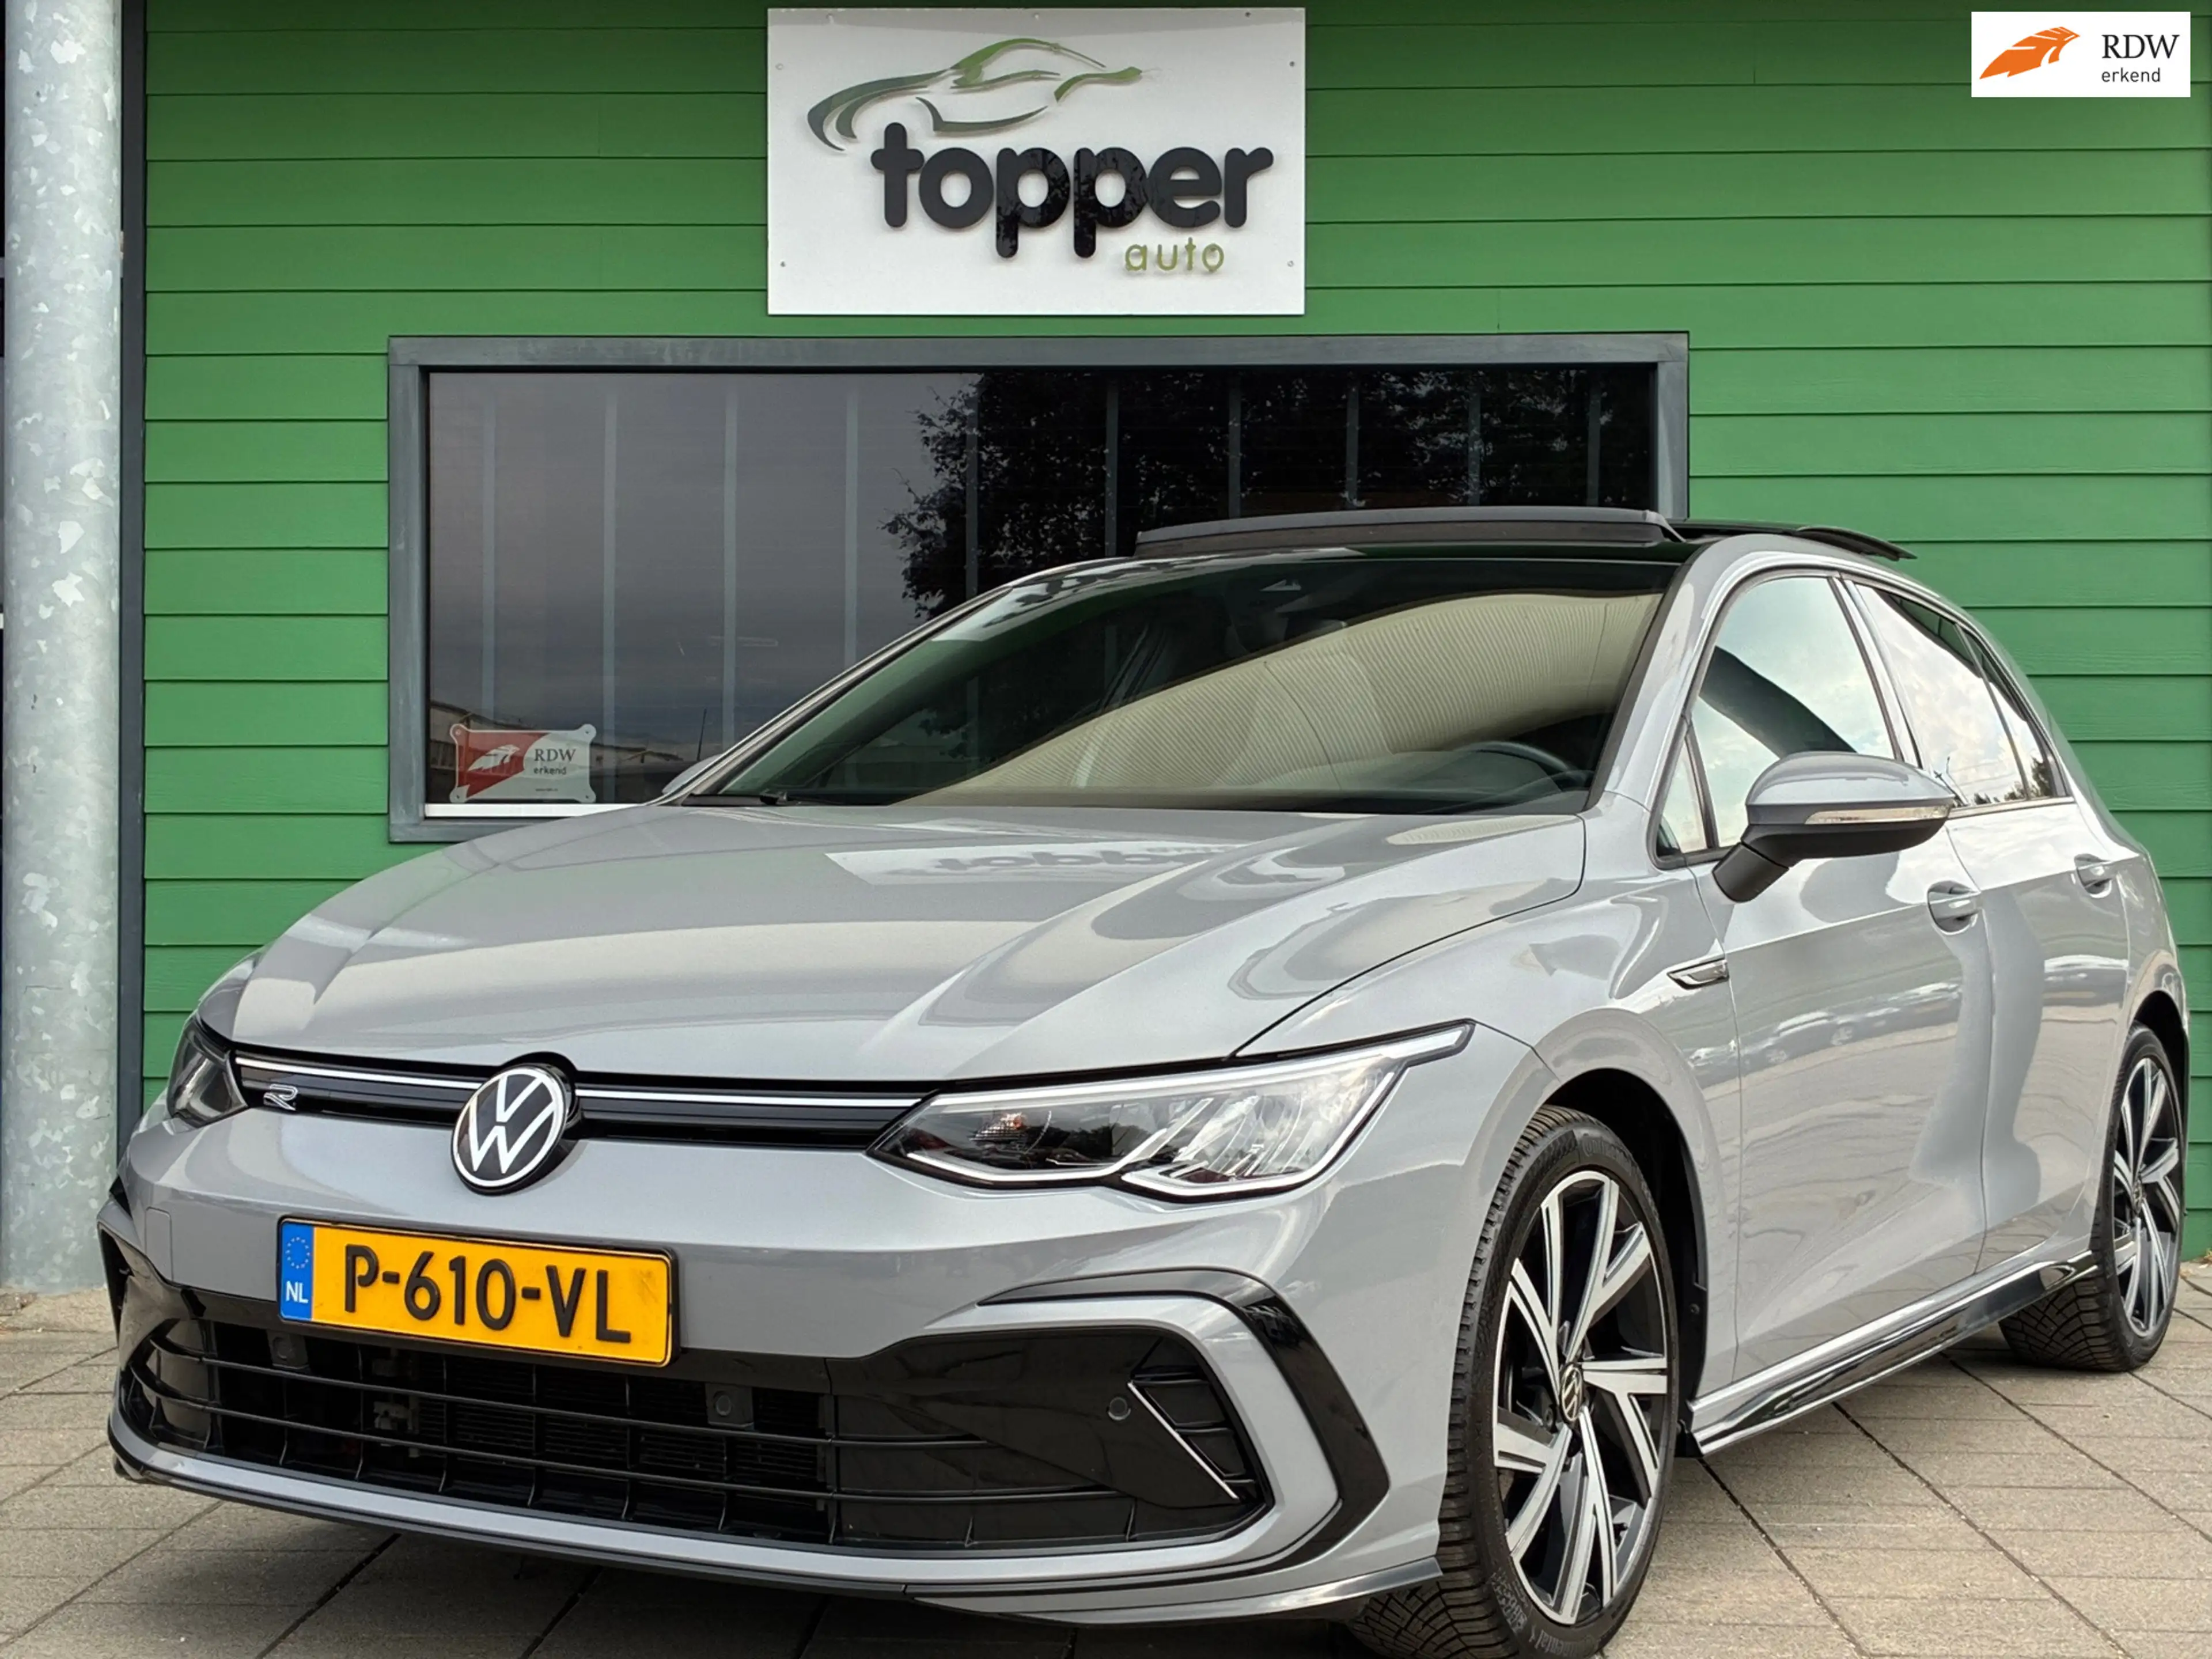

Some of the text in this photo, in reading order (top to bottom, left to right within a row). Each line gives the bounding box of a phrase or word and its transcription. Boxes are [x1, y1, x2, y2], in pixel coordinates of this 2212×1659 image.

[870, 122, 1274, 259] topper
[1125, 237, 1225, 272] auto
[534, 749, 575, 762] RDW
[533, 767, 566, 775] erkend
[286, 1281, 308, 1305] NL
[345, 1244, 631, 1343] P-610-VL
